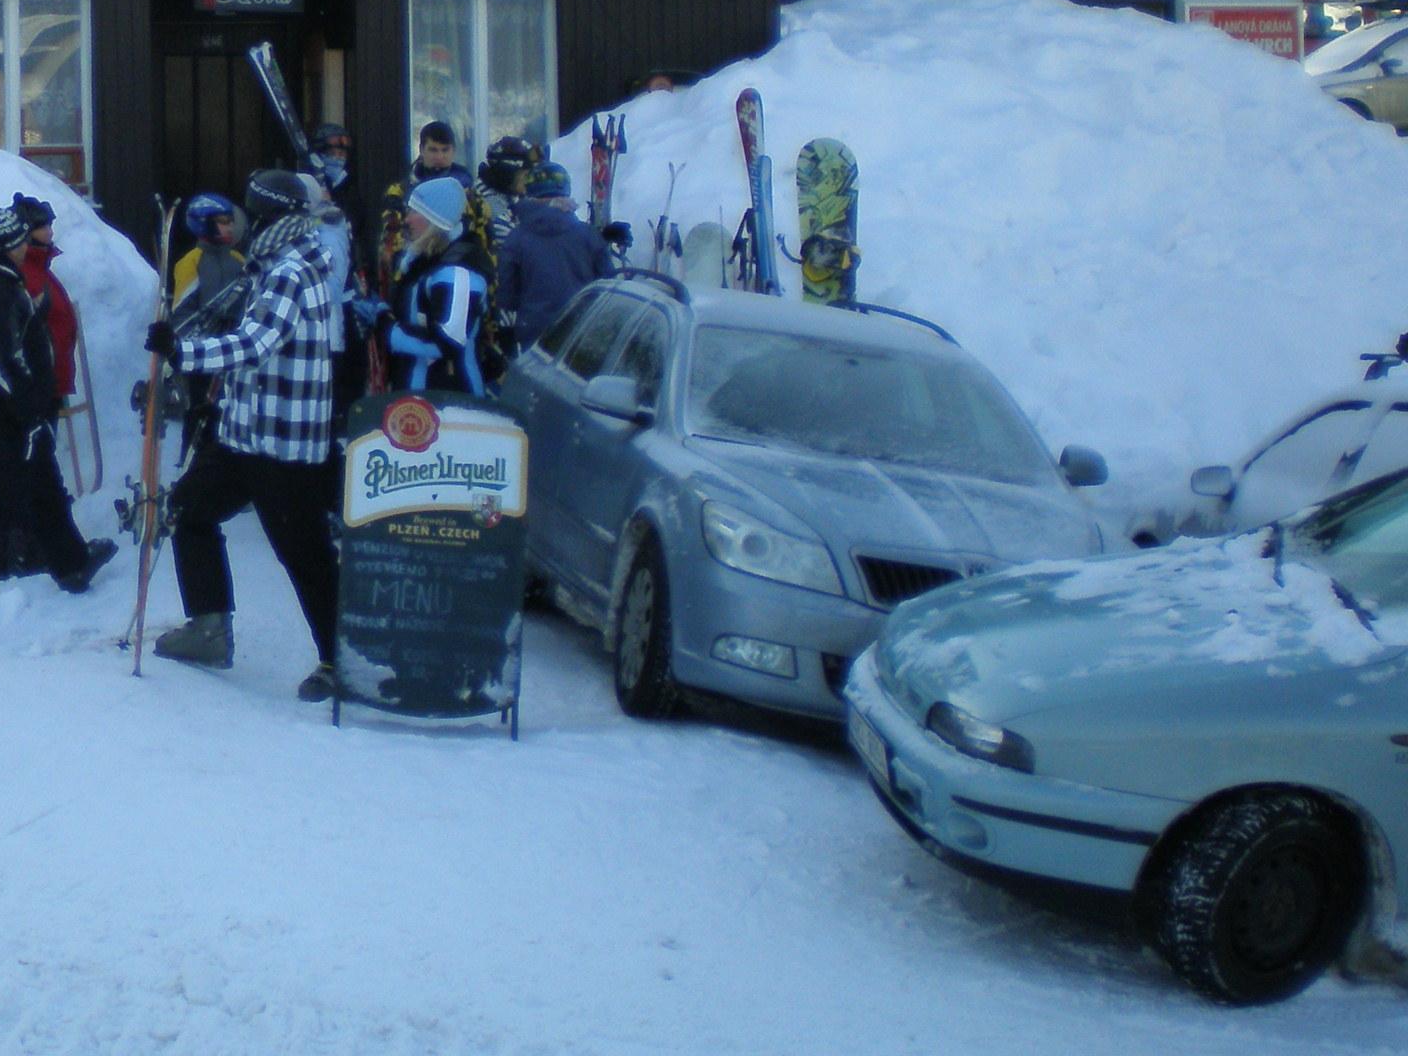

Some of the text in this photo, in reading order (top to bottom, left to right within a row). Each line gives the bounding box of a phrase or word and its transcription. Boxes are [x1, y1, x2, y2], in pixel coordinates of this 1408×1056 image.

[364, 449, 507, 499] Pilsner Urquell
[438, 527, 480, 540] CZECH
